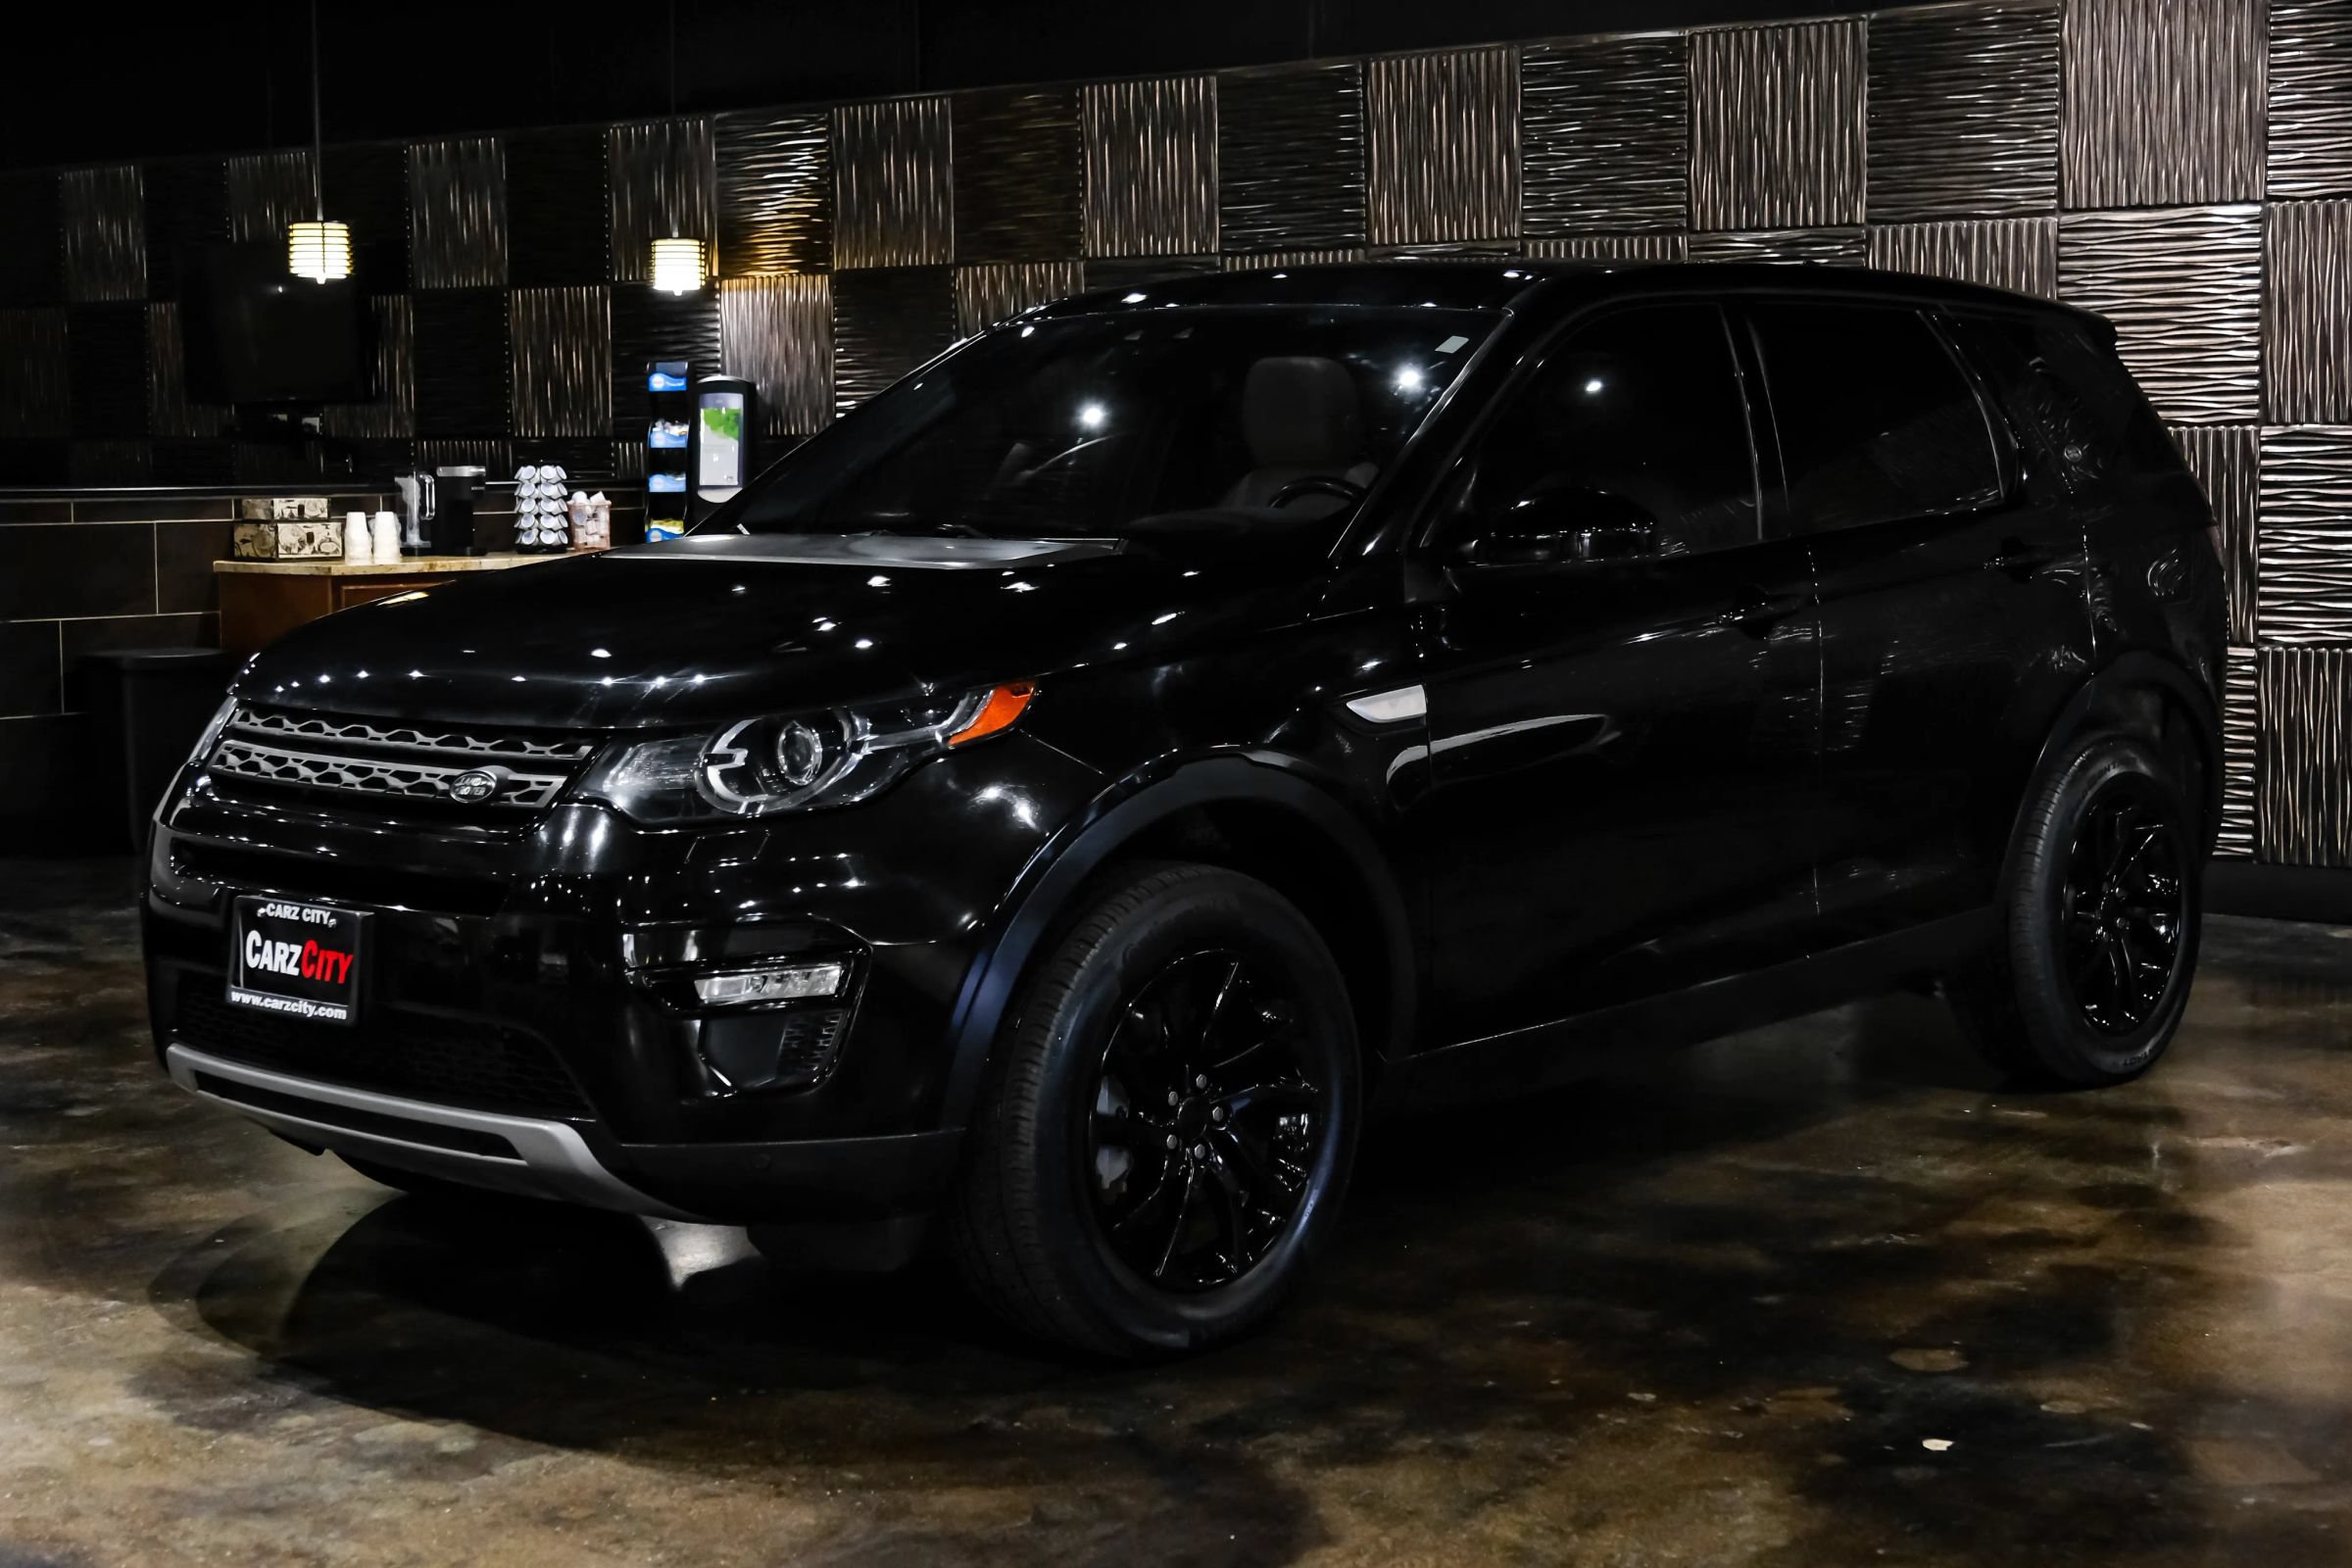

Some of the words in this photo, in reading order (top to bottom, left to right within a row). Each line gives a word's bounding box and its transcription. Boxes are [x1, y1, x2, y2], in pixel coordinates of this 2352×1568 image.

[266, 903, 300, 920] CARZ
[302, 907, 331, 925] CITY
[230, 991, 347, 1020] www.carzcity.com
